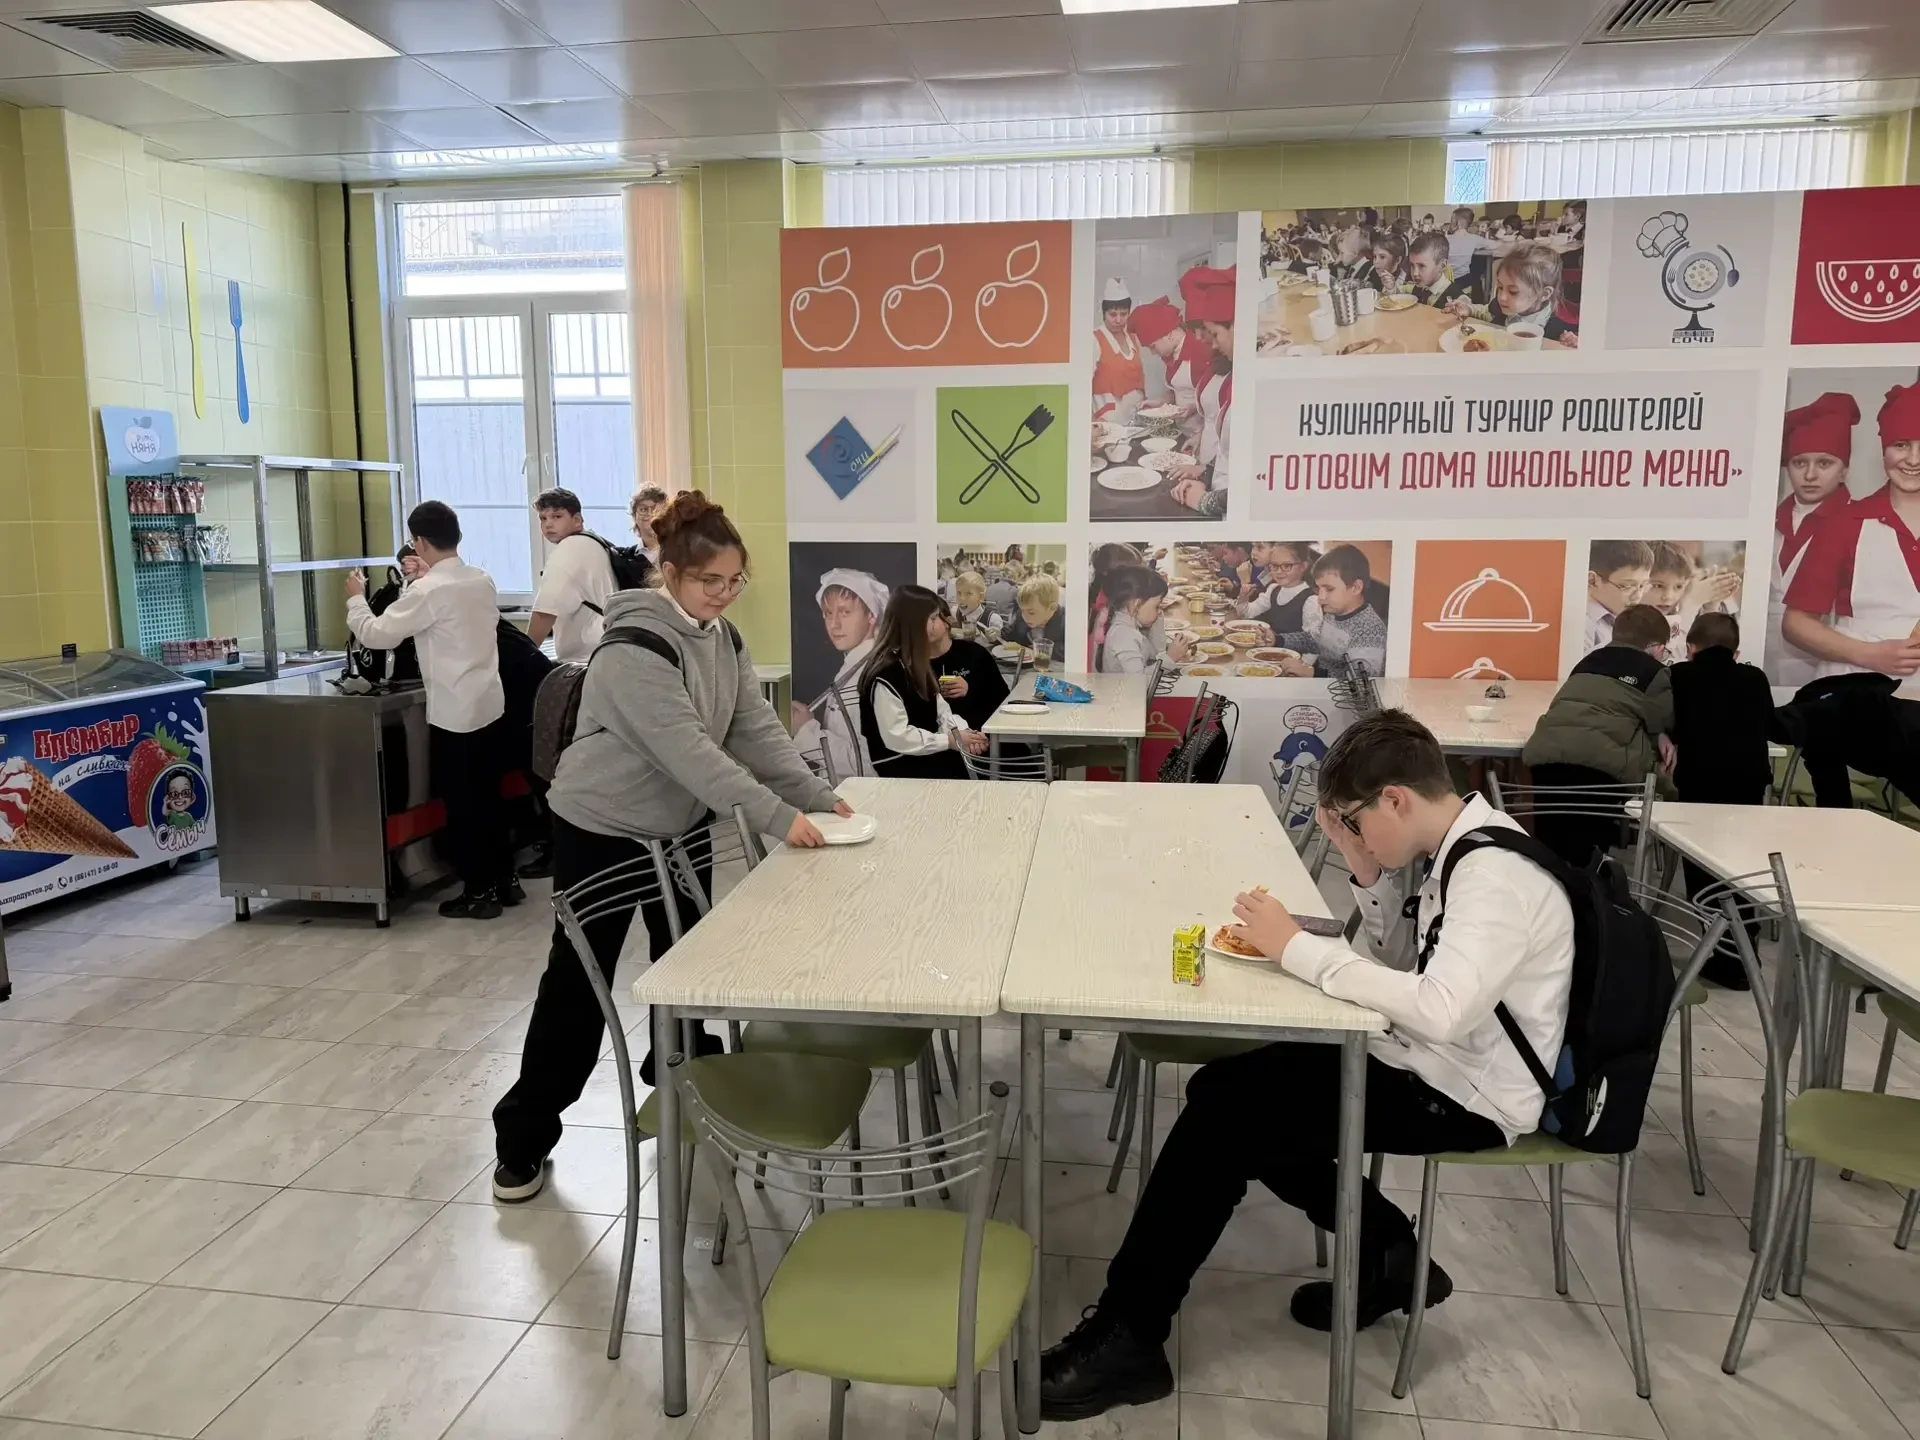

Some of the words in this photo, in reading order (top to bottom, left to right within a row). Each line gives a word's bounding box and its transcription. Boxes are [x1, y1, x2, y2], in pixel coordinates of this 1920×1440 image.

[1299, 395, 1455, 437] КУЛИНАРНЫЙ
[1464, 399, 1553, 433] ТУРНИР
[1562, 391, 1704, 433] РОДИТЕЛЕЙ
[1256, 452, 1391, 491] «ГОТОВИМ
[1399, 451, 1476, 490] ДОМА
[1486, 450, 1632, 488] ШКОЛЬНОЕ
[1642, 449, 1743, 488] МЕНЮ»
[58, 775, 72, 788] на
[77, 755, 128, 773] сливках
